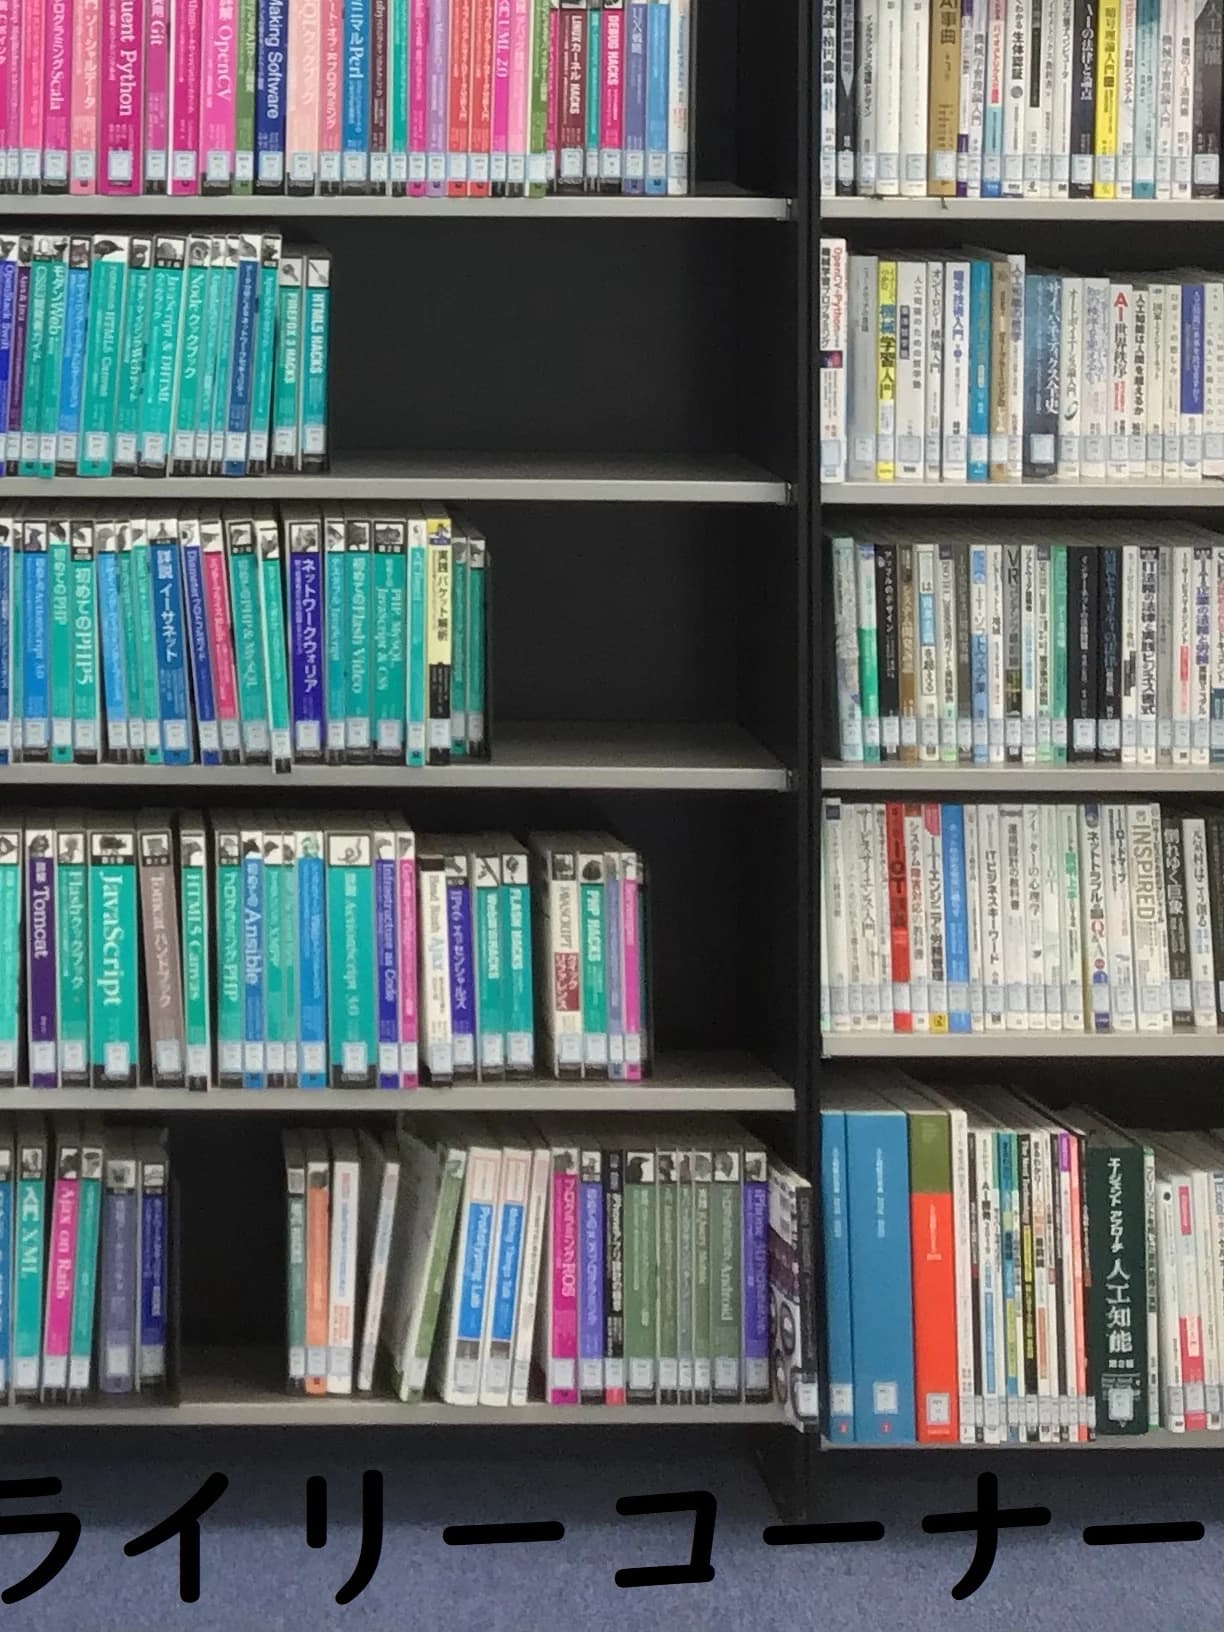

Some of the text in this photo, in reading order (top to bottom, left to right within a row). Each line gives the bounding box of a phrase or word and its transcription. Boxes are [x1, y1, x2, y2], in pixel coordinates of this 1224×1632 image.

[149, 19, 164, 46] Git
[213, 24, 232, 101] OpenCV
[116, 50, 137, 117] Python
[266, 51, 284, 120] Software
[189, 273, 205, 306] Node
[879, 303, 897, 400] 機械学習入門
[74, 566, 93, 686] 初めてのPHP5
[159, 583, 178, 663] イーサネット
[301, 557, 320, 693] ネットワークウォリア
[1131, 823, 1156, 920] INSPIRED
[32, 885, 50, 959] Tomcat
[96, 870, 124, 1006] JavaScript
[243, 862, 264, 988] 初めてのAnsible
[1106, 1257, 1134, 1354] 人工知能
